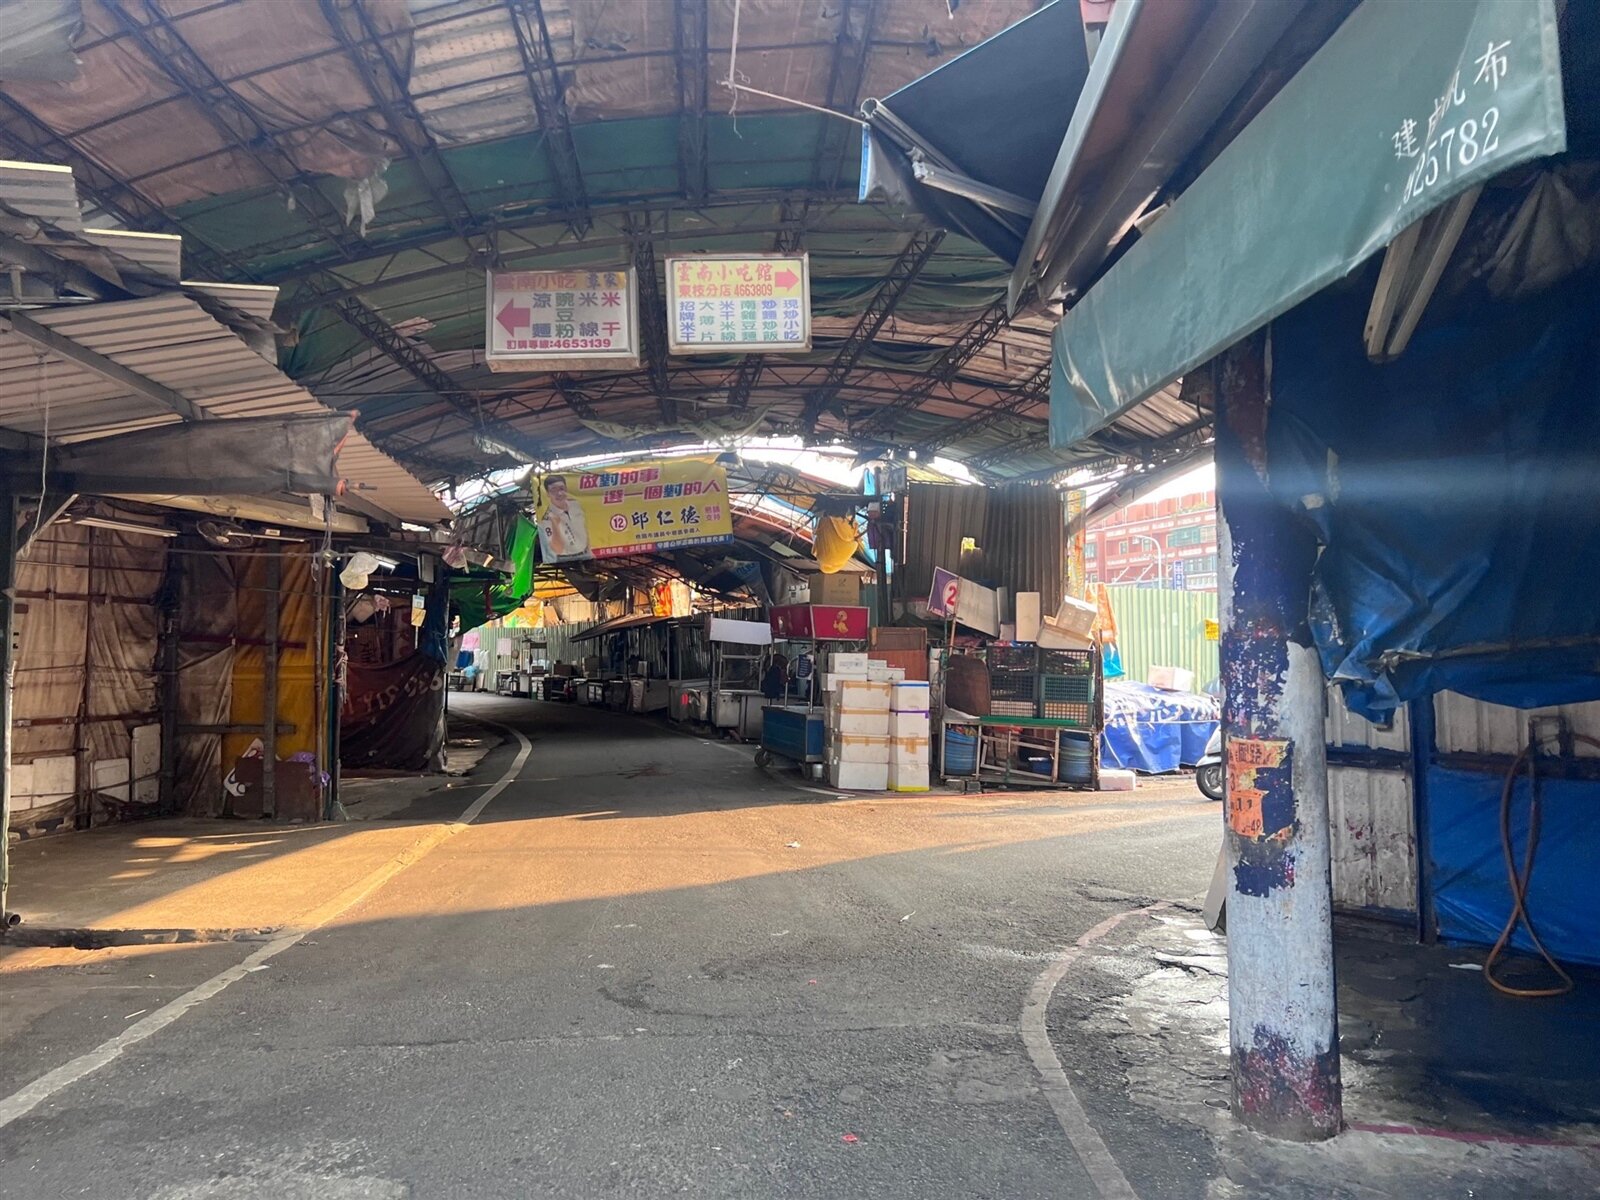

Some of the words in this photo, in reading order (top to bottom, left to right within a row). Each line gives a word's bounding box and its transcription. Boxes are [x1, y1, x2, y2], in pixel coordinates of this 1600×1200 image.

[677, 262, 773, 282] 雲南小吃館
[734, 283, 773, 297] 4663809
[579, 292, 599, 337] 米線
[579, 468, 660, 489] 做對的事
[603, 480, 720, 505] 選一個對的人
[631, 505, 701, 530] 邱仁德
[946, 586, 959, 606] 2
